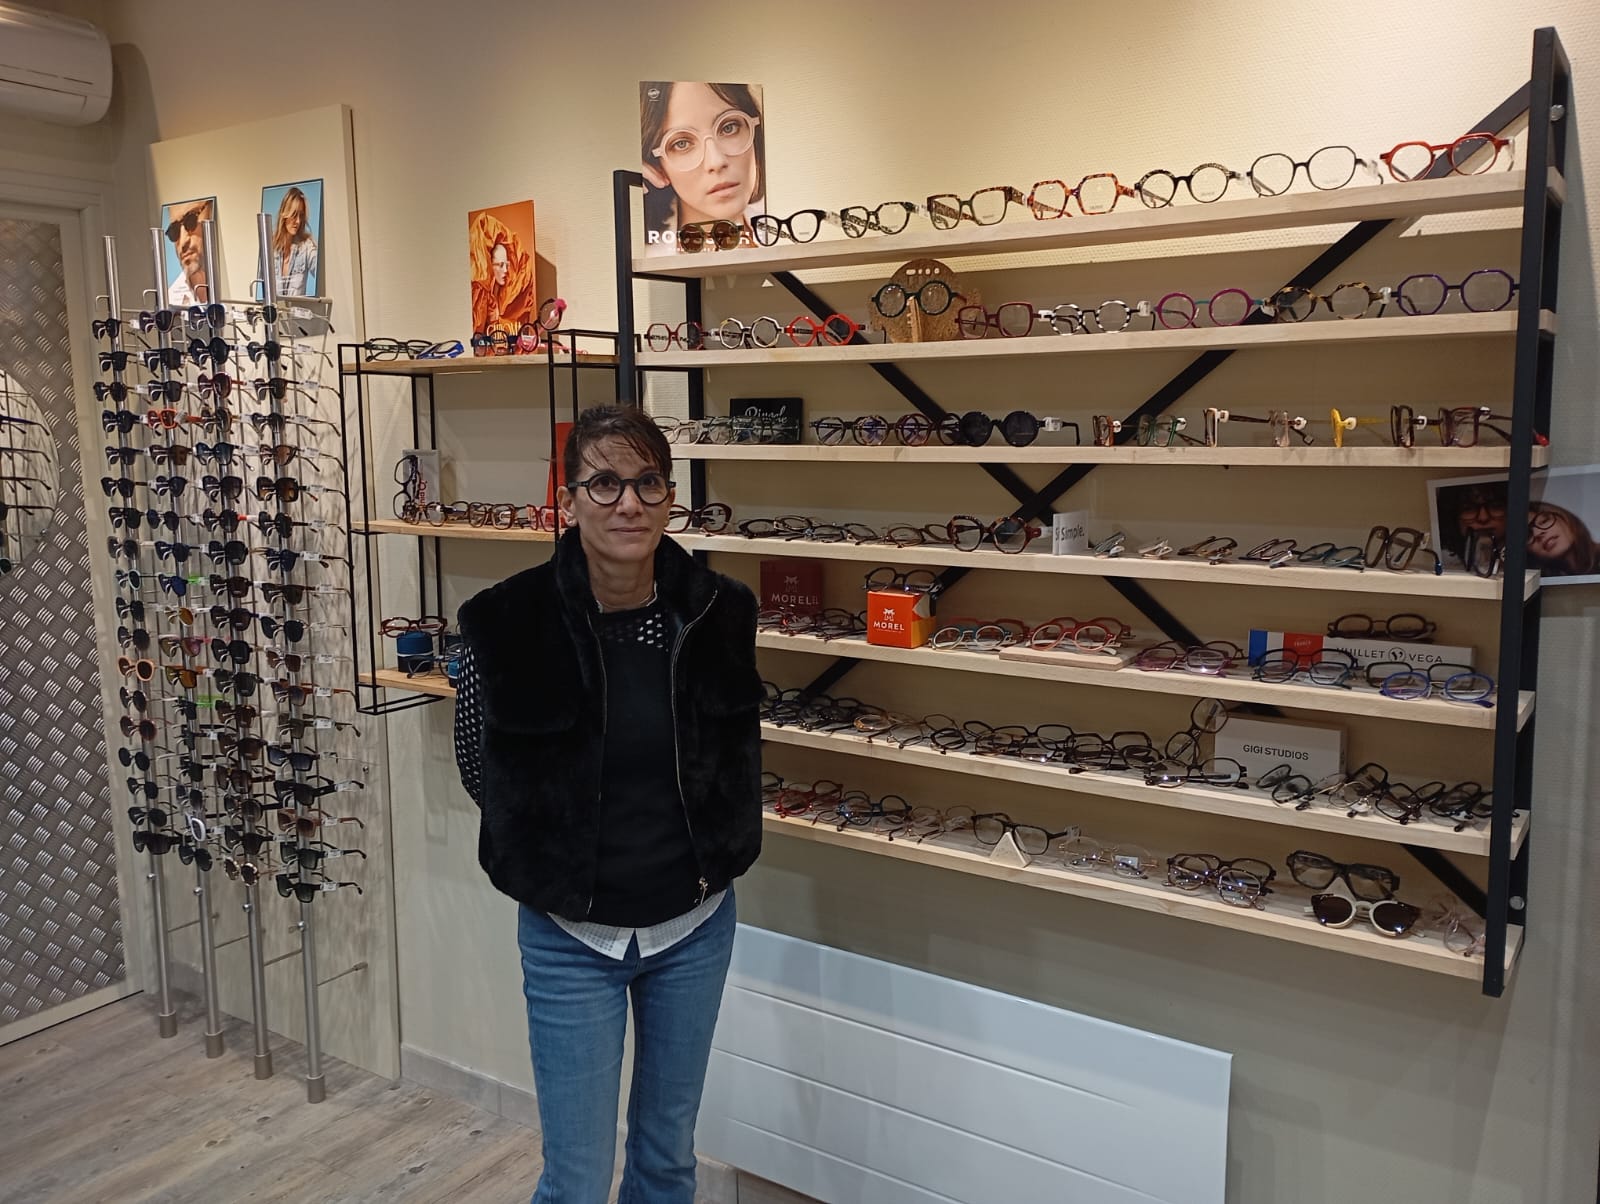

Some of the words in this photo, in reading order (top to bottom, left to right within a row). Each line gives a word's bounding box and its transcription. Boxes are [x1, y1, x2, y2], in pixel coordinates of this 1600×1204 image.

[771, 593, 812, 605] MOREL
[873, 620, 905, 631] MOREL
[1409, 653, 1443, 663] VEGA
[1243, 744, 1263, 754] GIGI
[1264, 747, 1309, 761] STUDIOS
